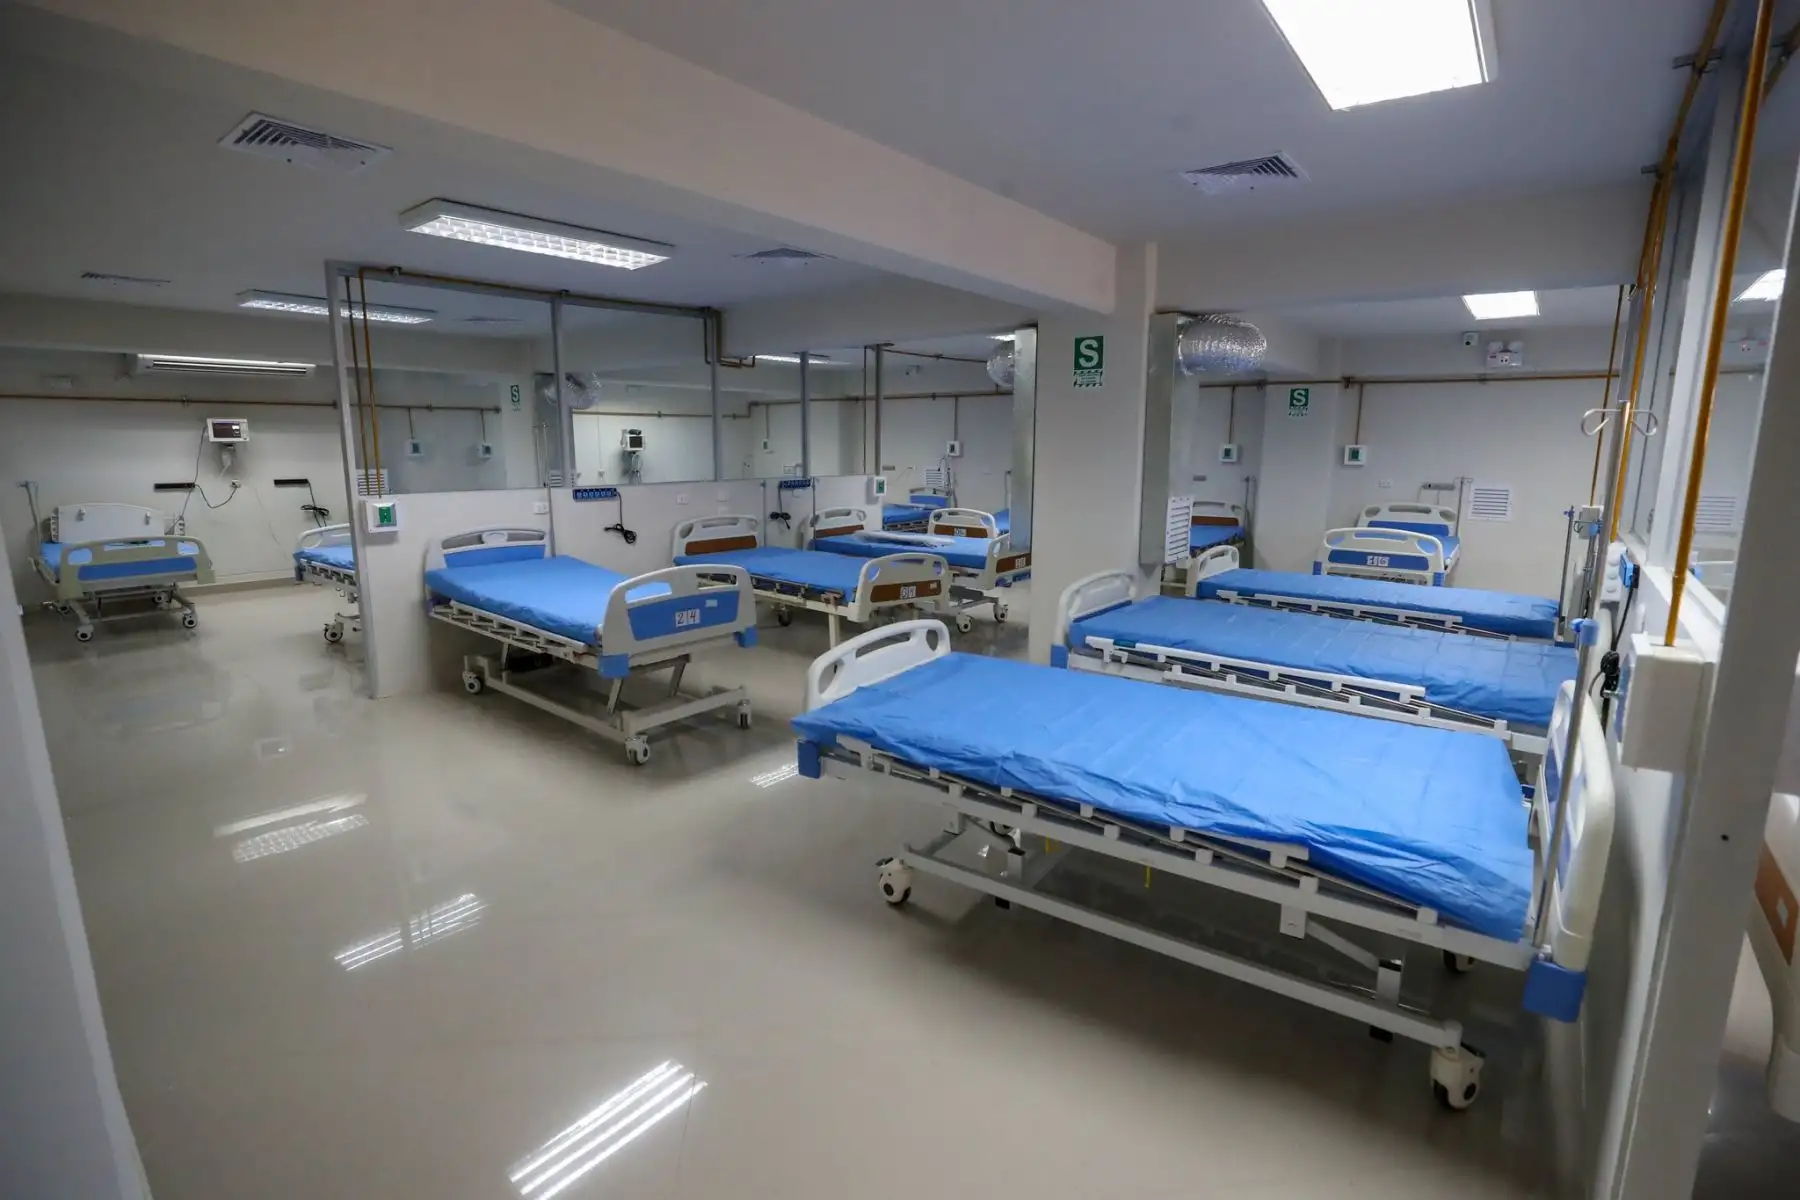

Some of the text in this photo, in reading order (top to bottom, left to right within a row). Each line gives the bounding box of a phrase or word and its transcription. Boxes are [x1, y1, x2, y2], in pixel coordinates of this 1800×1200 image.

[1079, 339, 1099, 368] S
[512, 386, 519, 402] S
[1292, 389, 1306, 406] S
